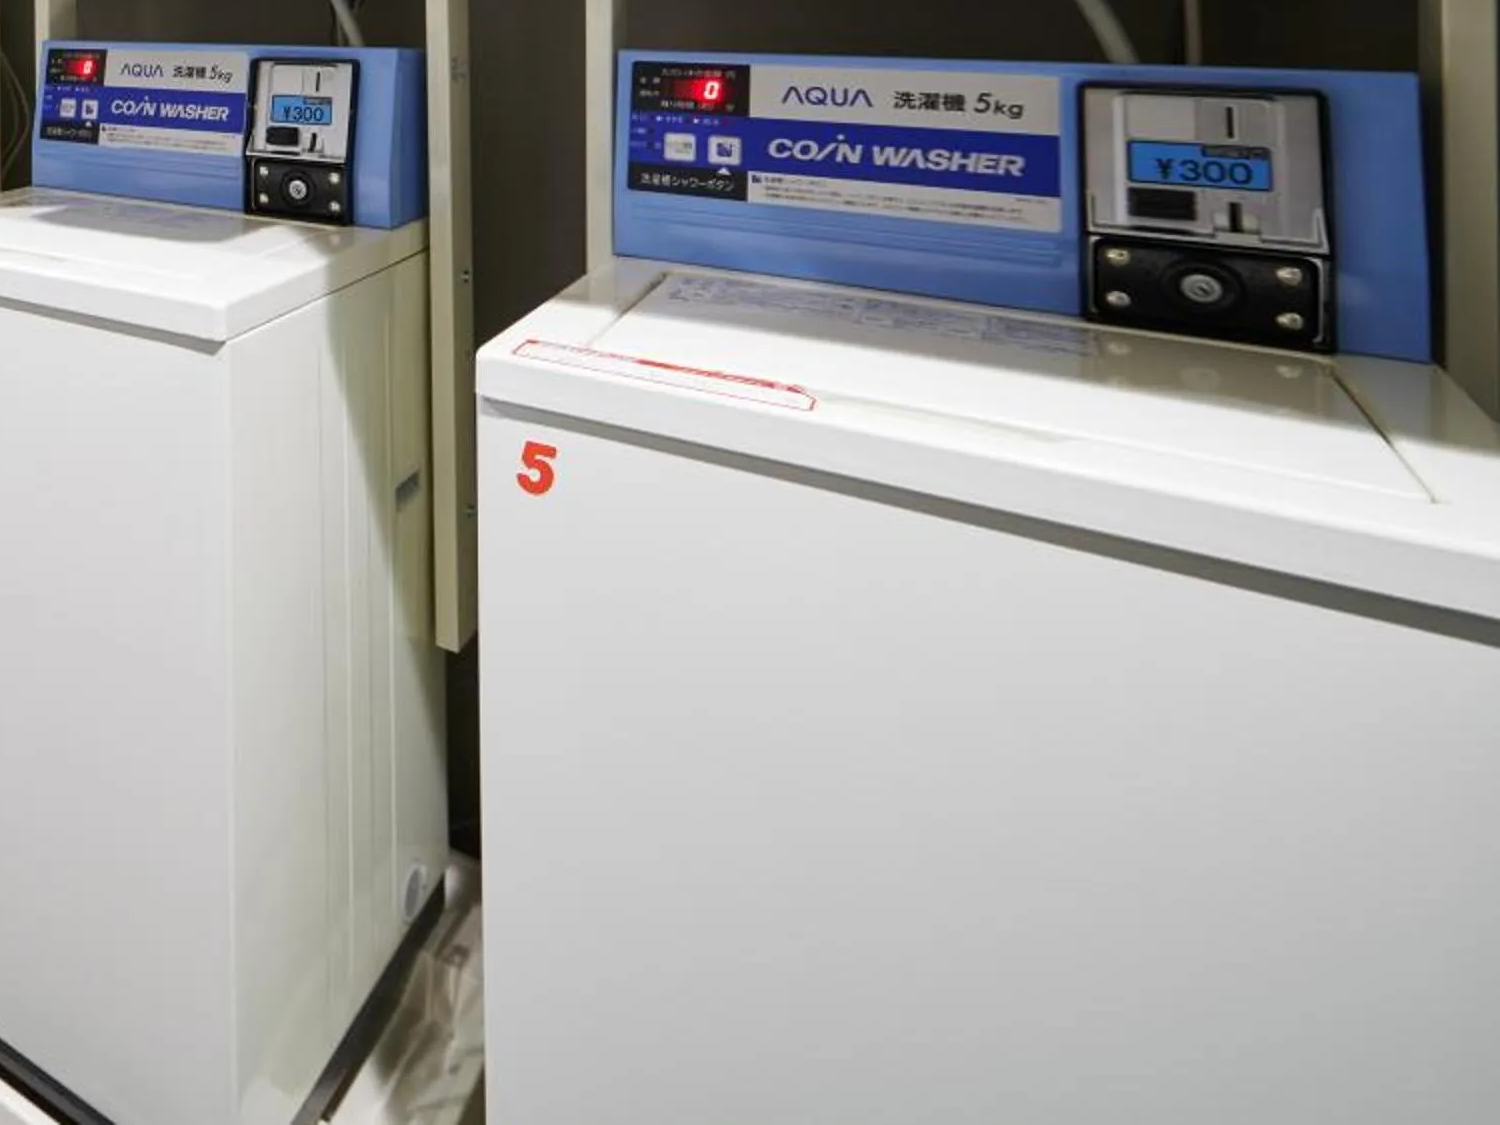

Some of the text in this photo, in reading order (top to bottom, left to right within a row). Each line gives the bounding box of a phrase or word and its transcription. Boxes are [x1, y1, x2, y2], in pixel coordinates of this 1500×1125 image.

[121, 62, 164, 78] AQUA
[208, 64, 233, 84] 5kg
[703, 81, 720, 100] 0
[781, 85, 1025, 120] AQUA 洗濯機 5kg
[159, 102, 229, 123] WASHER
[283, 105, 325, 123] ¥300
[872, 145, 1026, 177] WASHER
[1156, 158, 1254, 186] ¥300
[516, 441, 558, 496] 5
